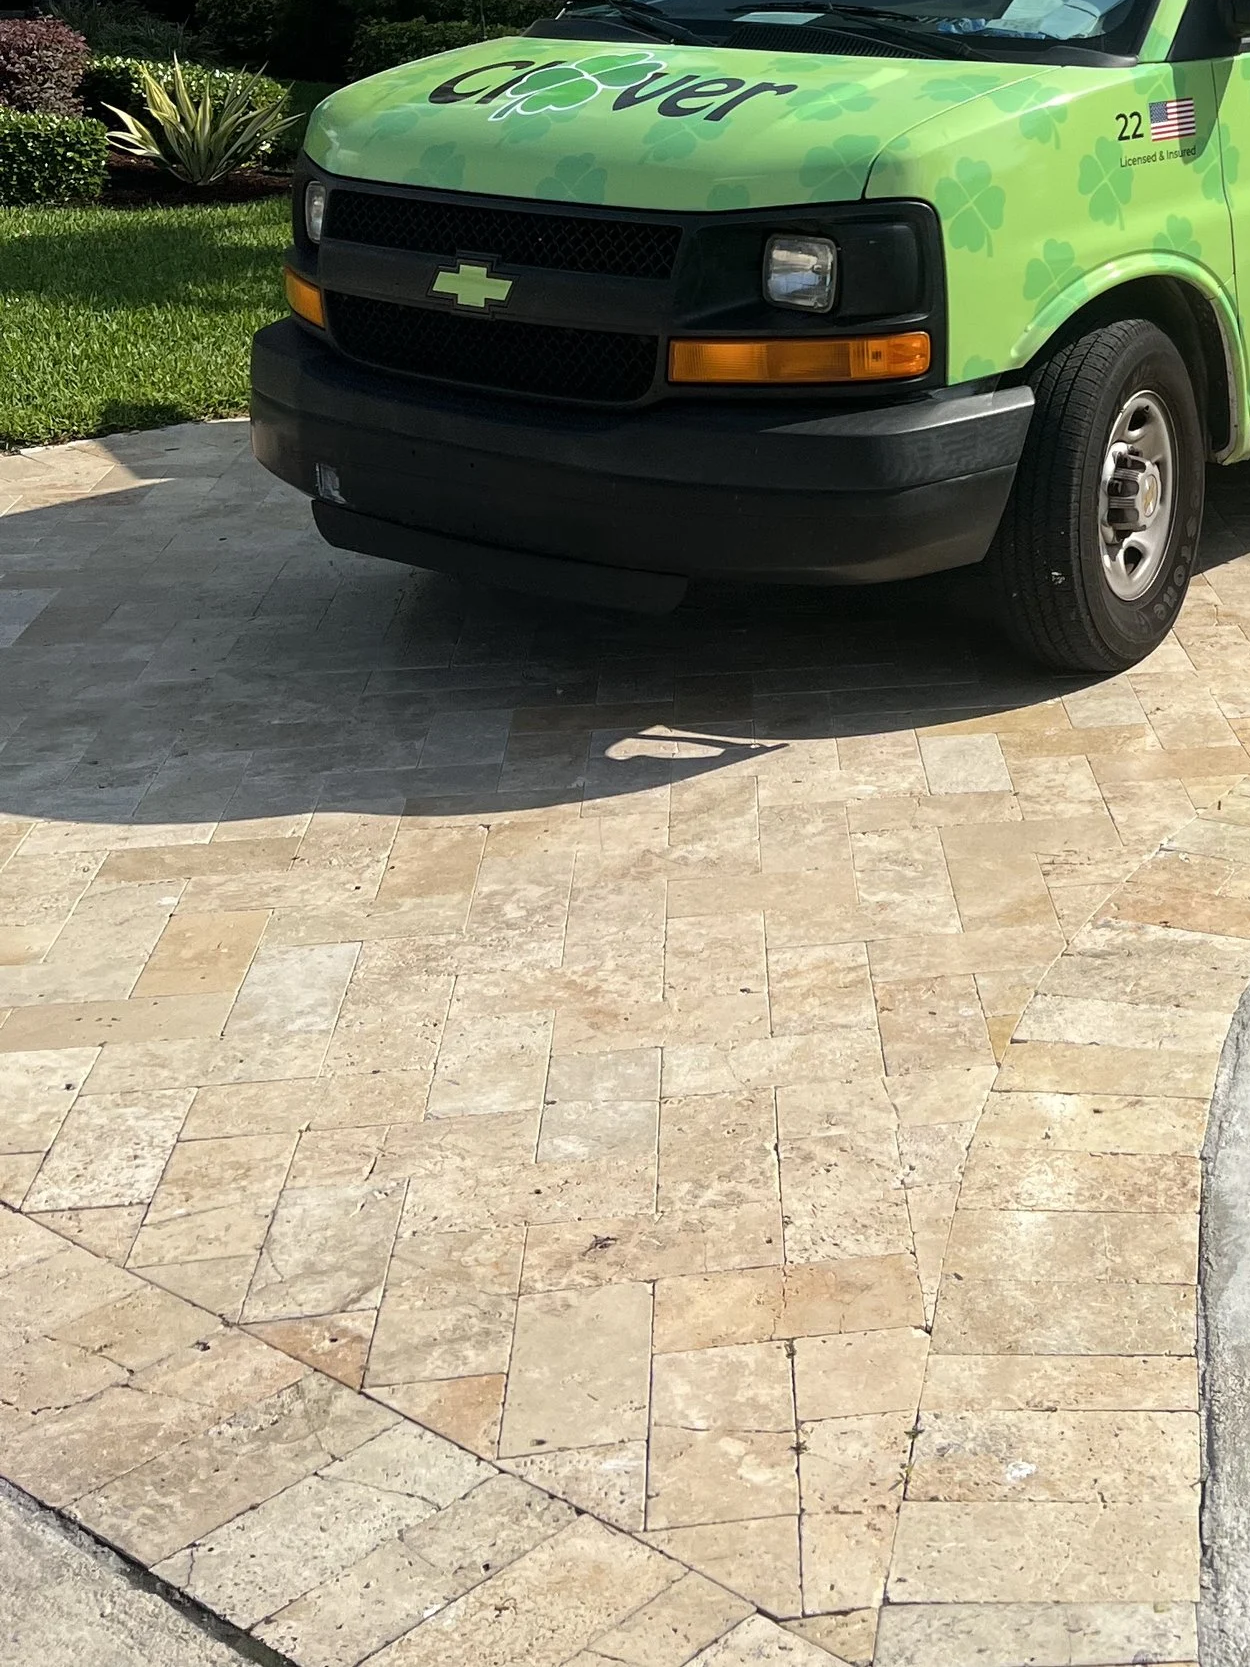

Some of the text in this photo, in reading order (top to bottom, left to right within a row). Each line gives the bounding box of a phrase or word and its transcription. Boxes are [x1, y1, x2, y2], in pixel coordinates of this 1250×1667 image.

[1115, 111, 1144, 141] 22
[1120, 145, 1196, 168] Licensed & Insured
